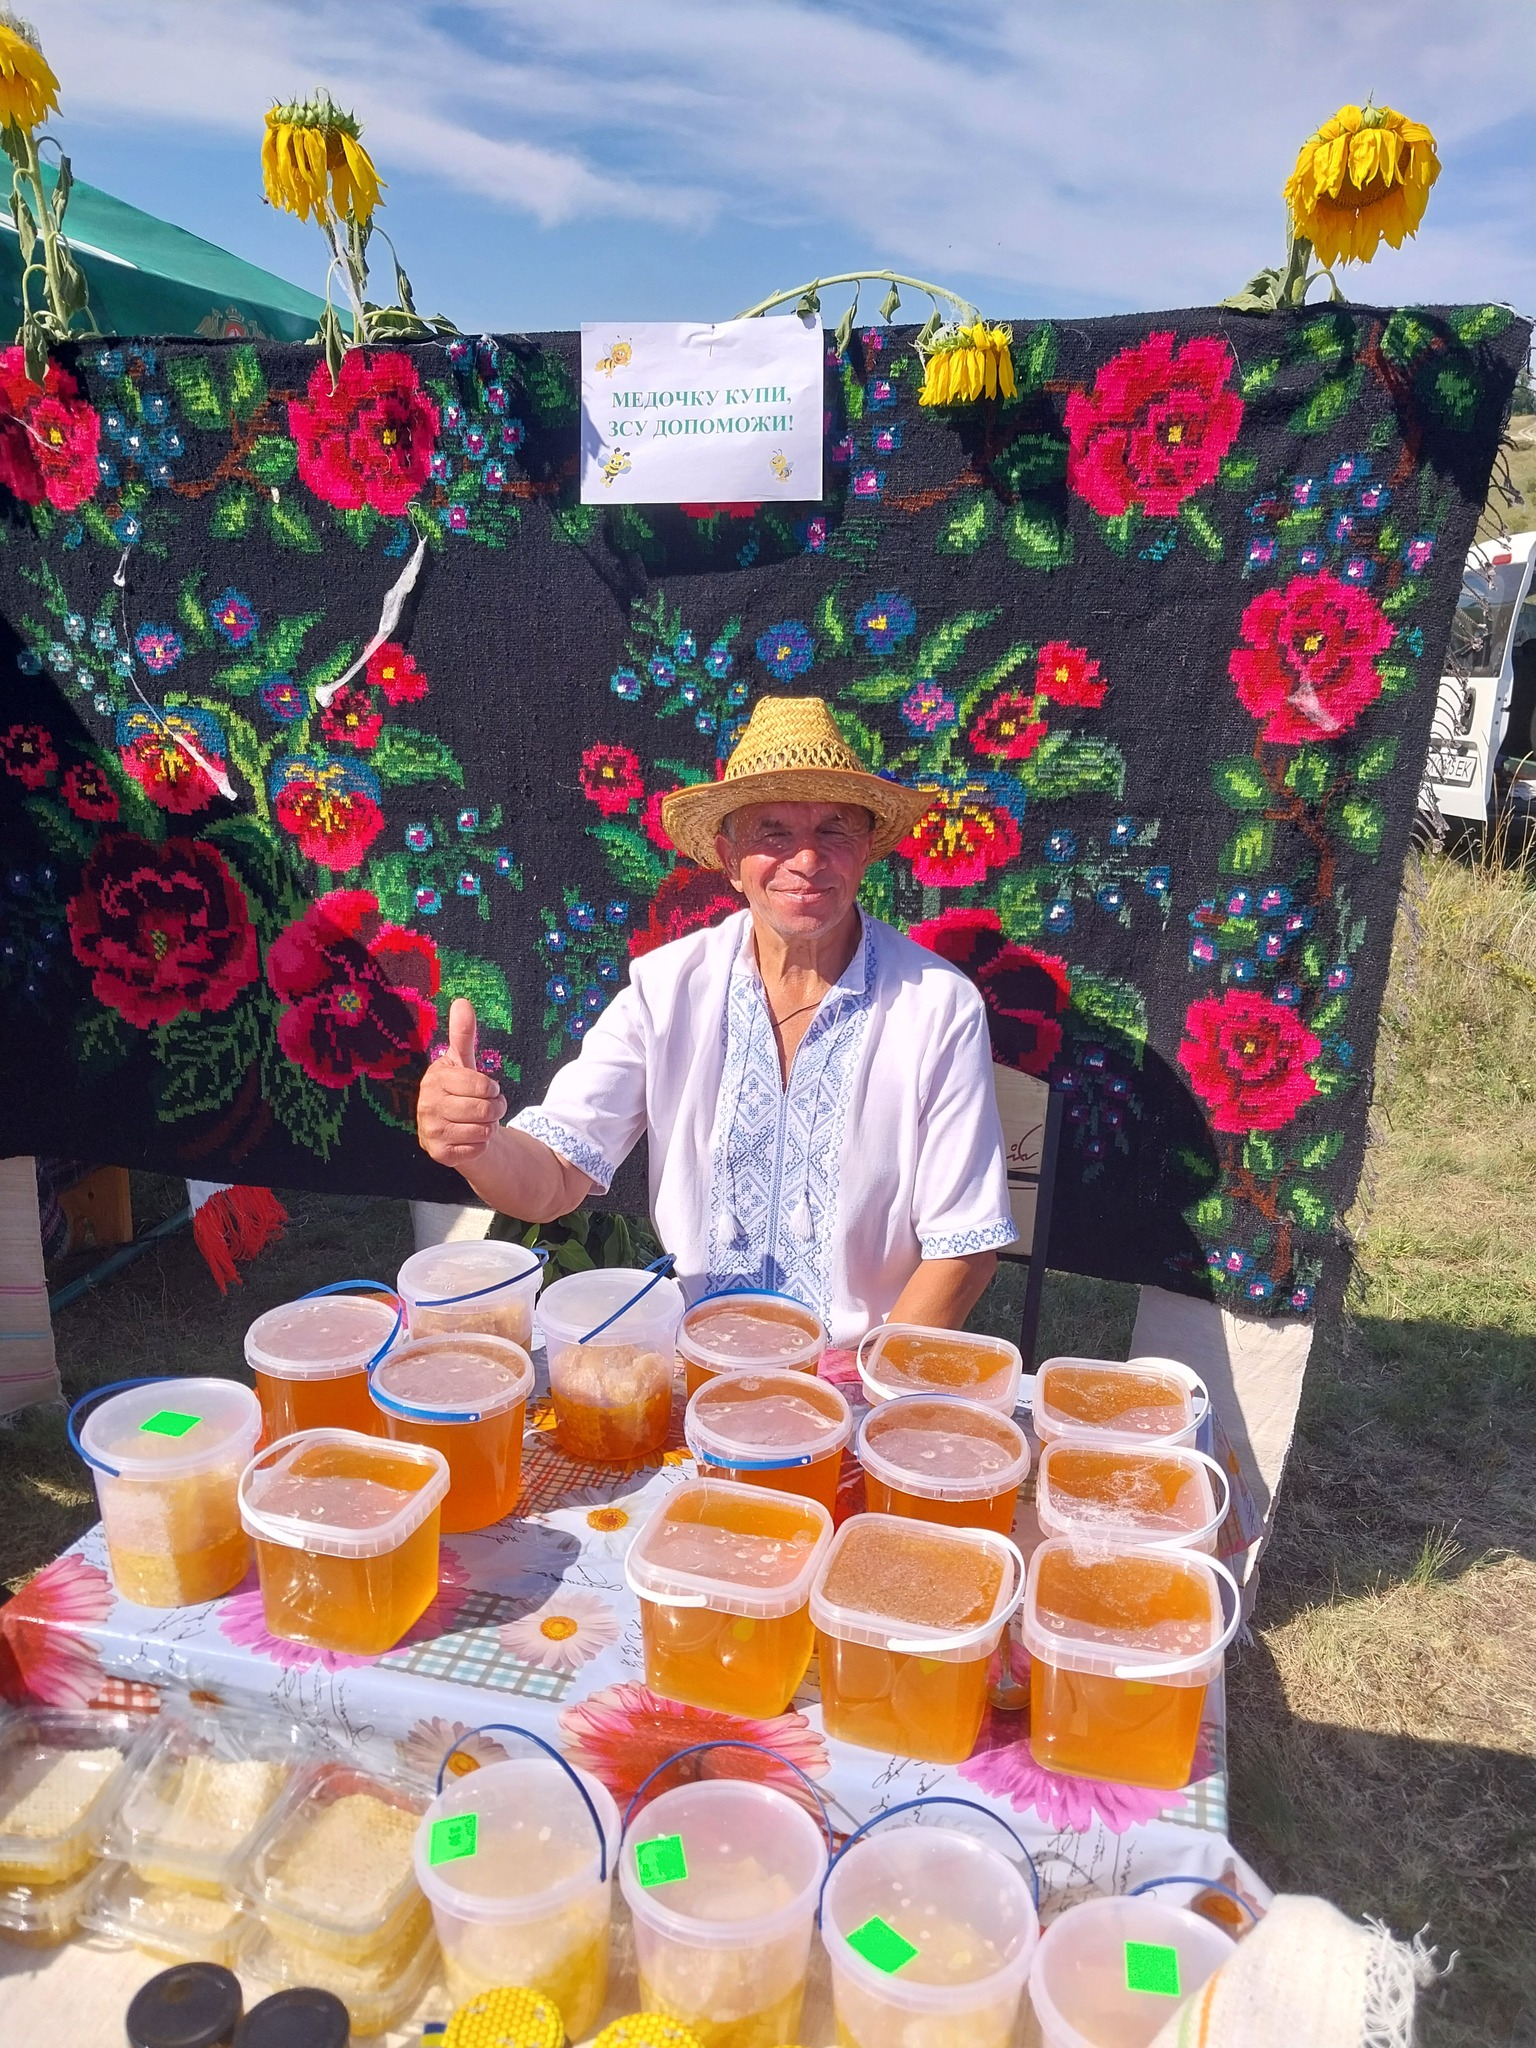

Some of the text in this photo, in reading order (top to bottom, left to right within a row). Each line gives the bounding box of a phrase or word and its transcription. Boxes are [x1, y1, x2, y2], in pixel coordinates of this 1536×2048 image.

[612, 386, 792, 411] МЕДОЧКУ КУПИ,
[608, 415, 794, 439] ЗСУ ДОПОМОЖИ!
